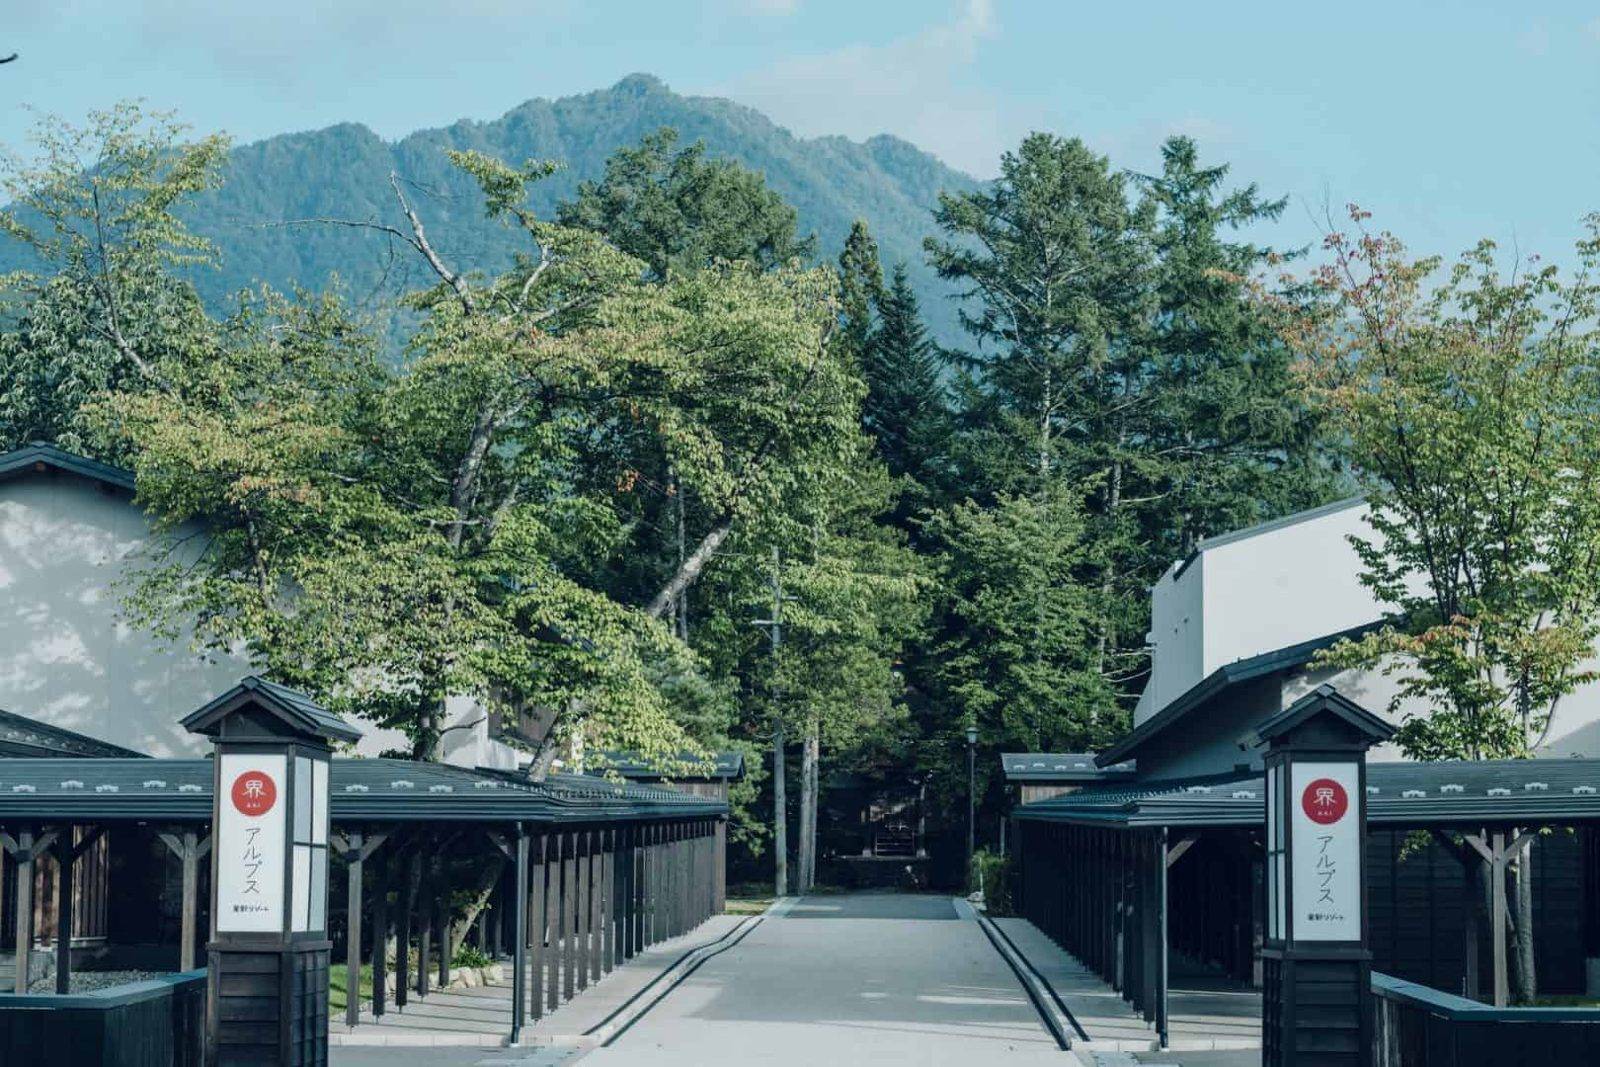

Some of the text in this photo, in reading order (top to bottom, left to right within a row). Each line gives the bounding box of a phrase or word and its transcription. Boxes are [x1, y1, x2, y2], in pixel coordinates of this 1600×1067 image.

[242, 779, 266, 798] 界
[1313, 787, 1337, 807] 界
[243, 827, 263, 894] アルプス
[1316, 835, 1336, 904] アルプス
